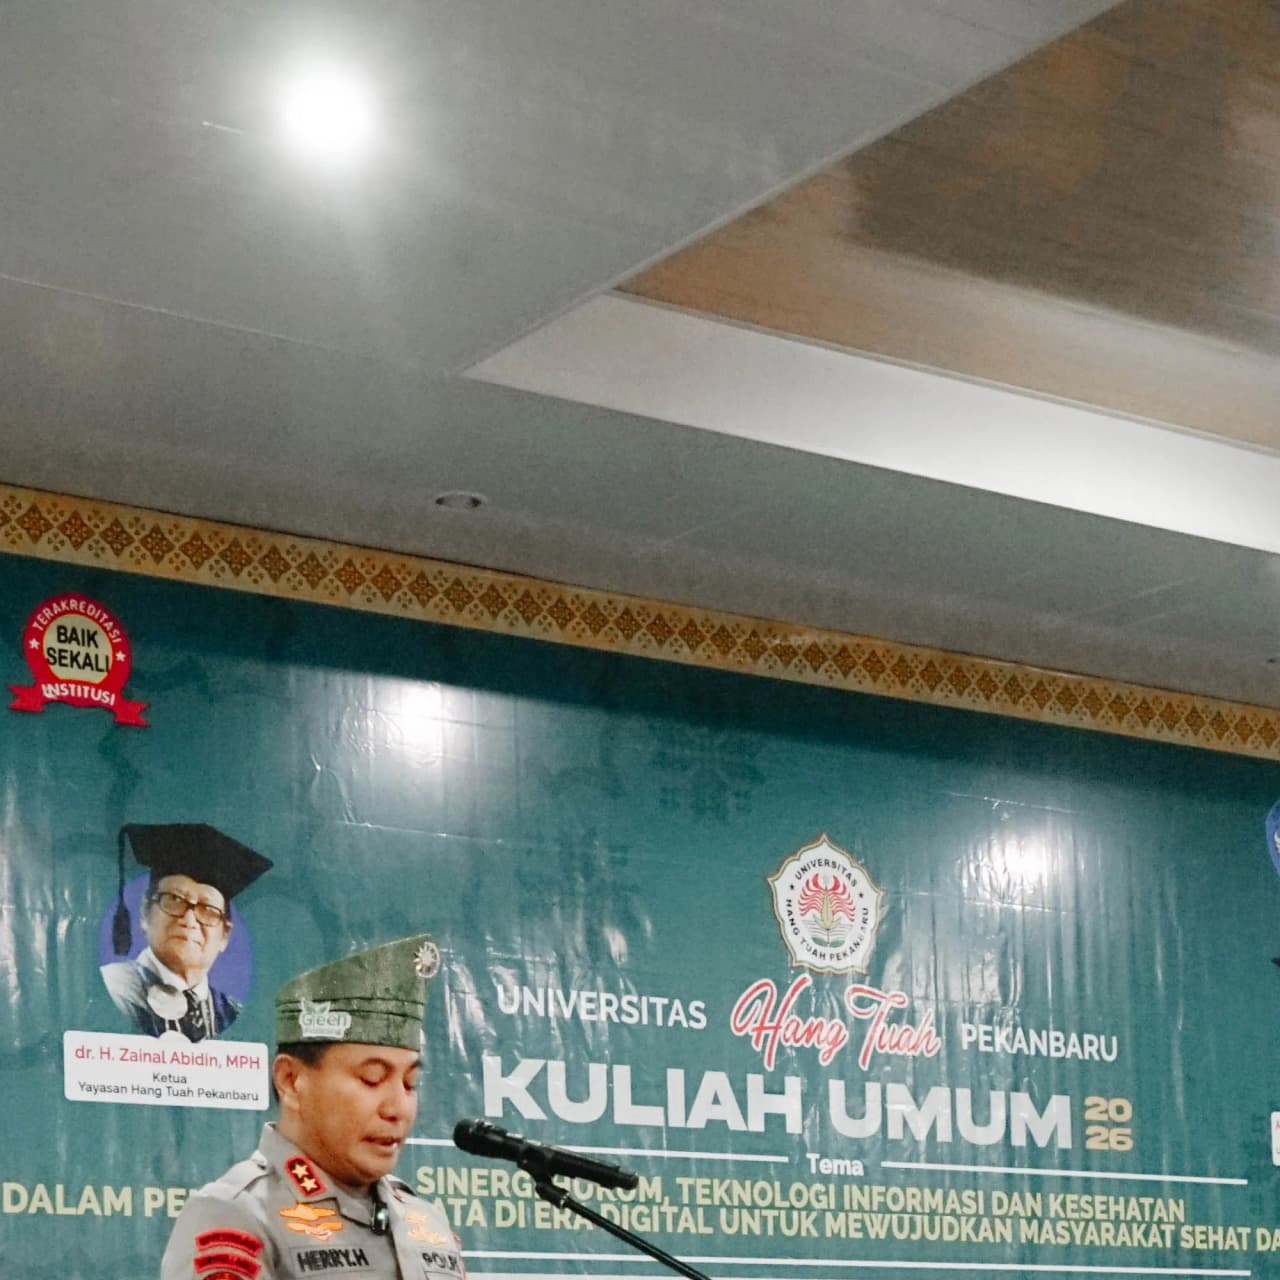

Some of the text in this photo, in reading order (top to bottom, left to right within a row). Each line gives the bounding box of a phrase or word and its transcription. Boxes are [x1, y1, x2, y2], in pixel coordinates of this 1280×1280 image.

[32, 599, 122, 643] TERAKREDITASI
[57, 625, 99, 648] BAIK
[47, 647, 110, 673] SEKALI
[41, 683, 116, 706] INSTITUSI
[795, 858, 857, 887] UNIVERSITAS
[786, 899, 800, 935] HANG
[801, 938, 826, 961] TUAH
[497, 974, 1118, 1071] UNIVERSITAS Hang Tuah PEKANBARU
[75, 1045, 260, 1069] dr. H. Zainal Abidin, MPH
[79, 1081, 259, 1102] Yayasan Hang Tuah Pekanbaru
[153, 1073, 187, 1084] Ketua
[483, 1055, 1072, 1149] KULIAH UMUM
[1084, 1096, 1132, 1123] 20
[1085, 1125, 1134, 1151] 26
[807, 1153, 864, 1176] Tema
[3, 1182, 132, 1216] DALAM
[416, 1166, 537, 1198] SINERG
[676, 1177, 835, 1210] TEKNOLOGI
[844, 1184, 984, 1216] INFORMASI
[992, 1191, 1041, 1217] DAN
[1049, 1191, 1185, 1223] KESEHATAN
[496, 1199, 527, 1228] DI
[535, 1205, 594, 1231] ERA
[600, 1203, 714, 1234] DIGITAL
[720, 1207, 819, 1237] UNTUK
[825, 1212, 1013, 1243] MEWUJUDKAN
[1020, 1217, 1175, 1249] MASYARAKAT
[1180, 1225, 1251, 1250] SEHAT
[297, 1248, 370, 1273] HERRY.H
